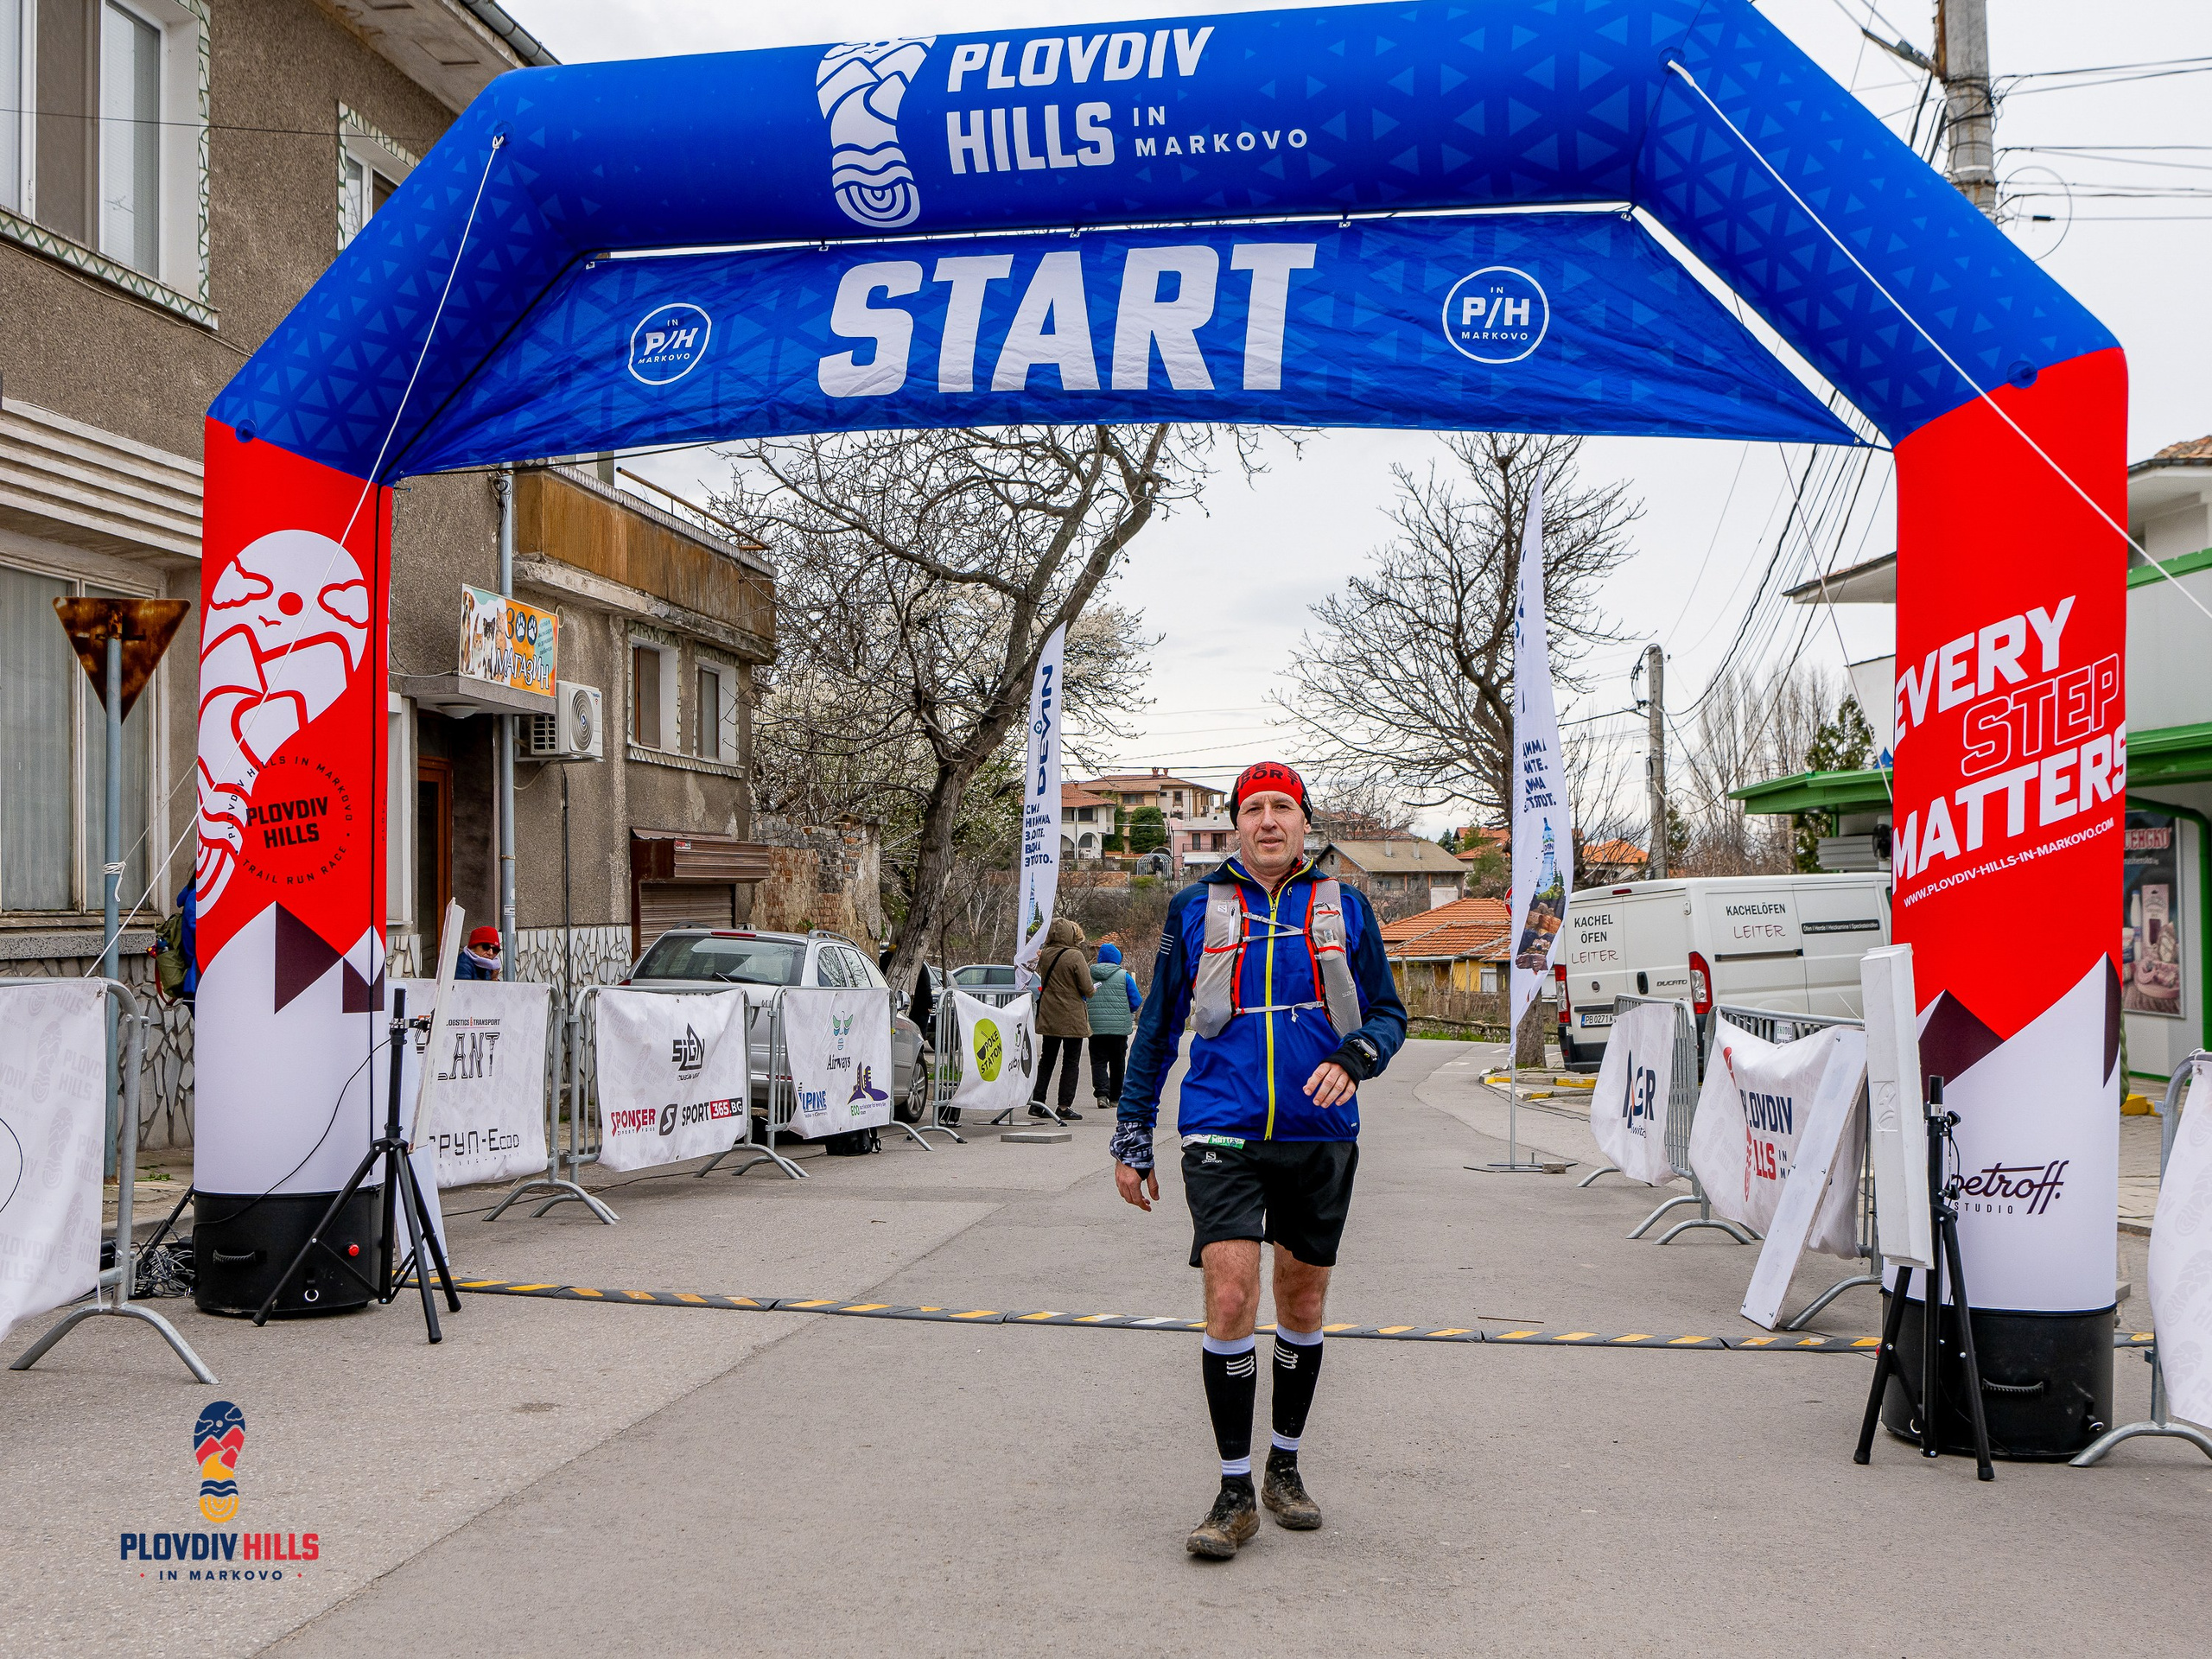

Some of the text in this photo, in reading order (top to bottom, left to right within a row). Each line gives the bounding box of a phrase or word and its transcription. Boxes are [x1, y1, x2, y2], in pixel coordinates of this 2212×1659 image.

[947, 27, 1215, 92] PLOVDIV
[1133, 106, 1166, 126] IN
[947, 101, 1115, 175] HILLS
[1135, 129, 1307, 157] MARKOVO
[817, 243, 1317, 397] START
[1461, 296, 1530, 328] P/H
[644, 327, 698, 356] P/H
[1461, 331, 1529, 340] MARKOVO
[638, 353, 690, 364] MARKOVO
[495, 647, 550, 690] МАГАЗИН
[1894, 594, 2076, 751] EVERY
[1961, 652, 2120, 777] STEP
[227, 779, 245, 839] PLOVDIV
[247, 755, 286, 778] HILLS
[295, 756, 309, 766] IN
[316, 763, 353, 821] MARKOVO
[1892, 720, 2126, 895] MATTERS
[246, 796, 327, 827] PLOVDIV
[264, 823, 320, 849] HILLS
[243, 845, 346, 884] TRAIL RUN RACE
[1904, 817, 2114, 907] WWW.PLOVDIV-HILLS-IN-MARKOVO.COM
[1574, 914, 1613, 928] KACHEL
[1726, 902, 1786, 916] KACHELÖFEN
[1580, 930, 1607, 944] ÖFEN
[1733, 924, 1786, 939] LEITER
[1571, 950, 1618, 964] LEITER
[984, 1030, 999, 1052] POKE
[826, 1054, 851, 1072] Airways
[611, 1108, 656, 1137] SPONSER
[1778, 1149, 1788, 1162] IN
[1954, 1201, 2013, 1214] STUDIO
